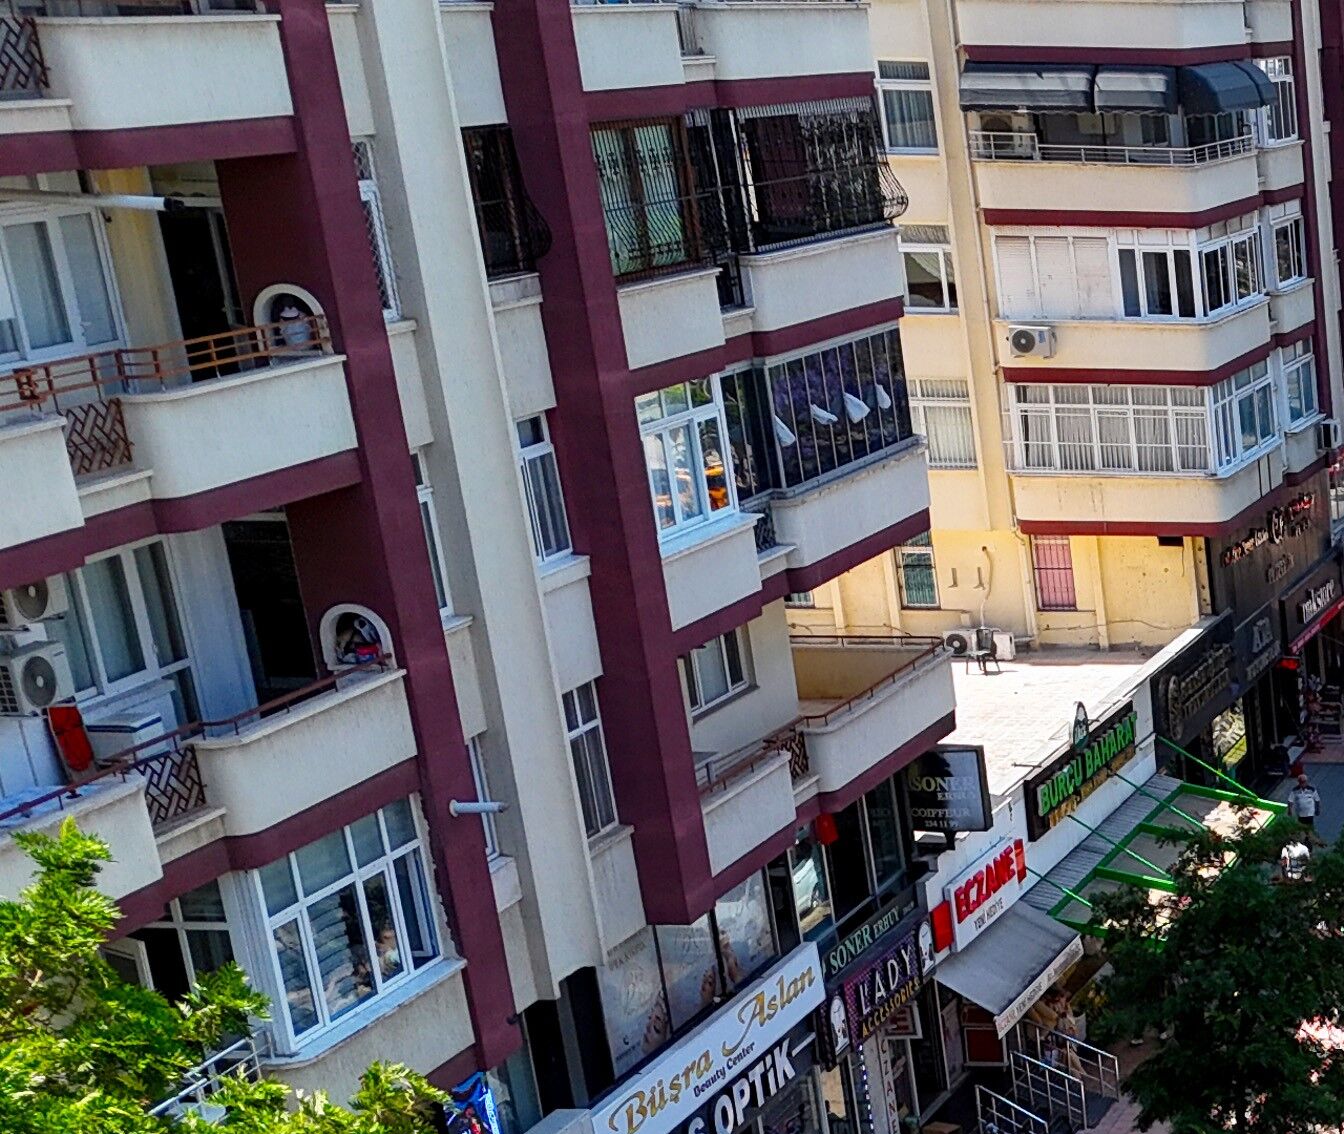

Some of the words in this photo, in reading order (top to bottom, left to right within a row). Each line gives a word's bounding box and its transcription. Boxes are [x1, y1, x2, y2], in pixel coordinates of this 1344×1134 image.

[1084, 711, 1137, 780] BAHARAT
[954, 846, 1016, 924] ECZANE
[829, 924, 874, 975] SONER
[721, 966, 816, 1057] Aslan
[693, 1066, 727, 1098] Beauty
[726, 1041, 756, 1070] Center
